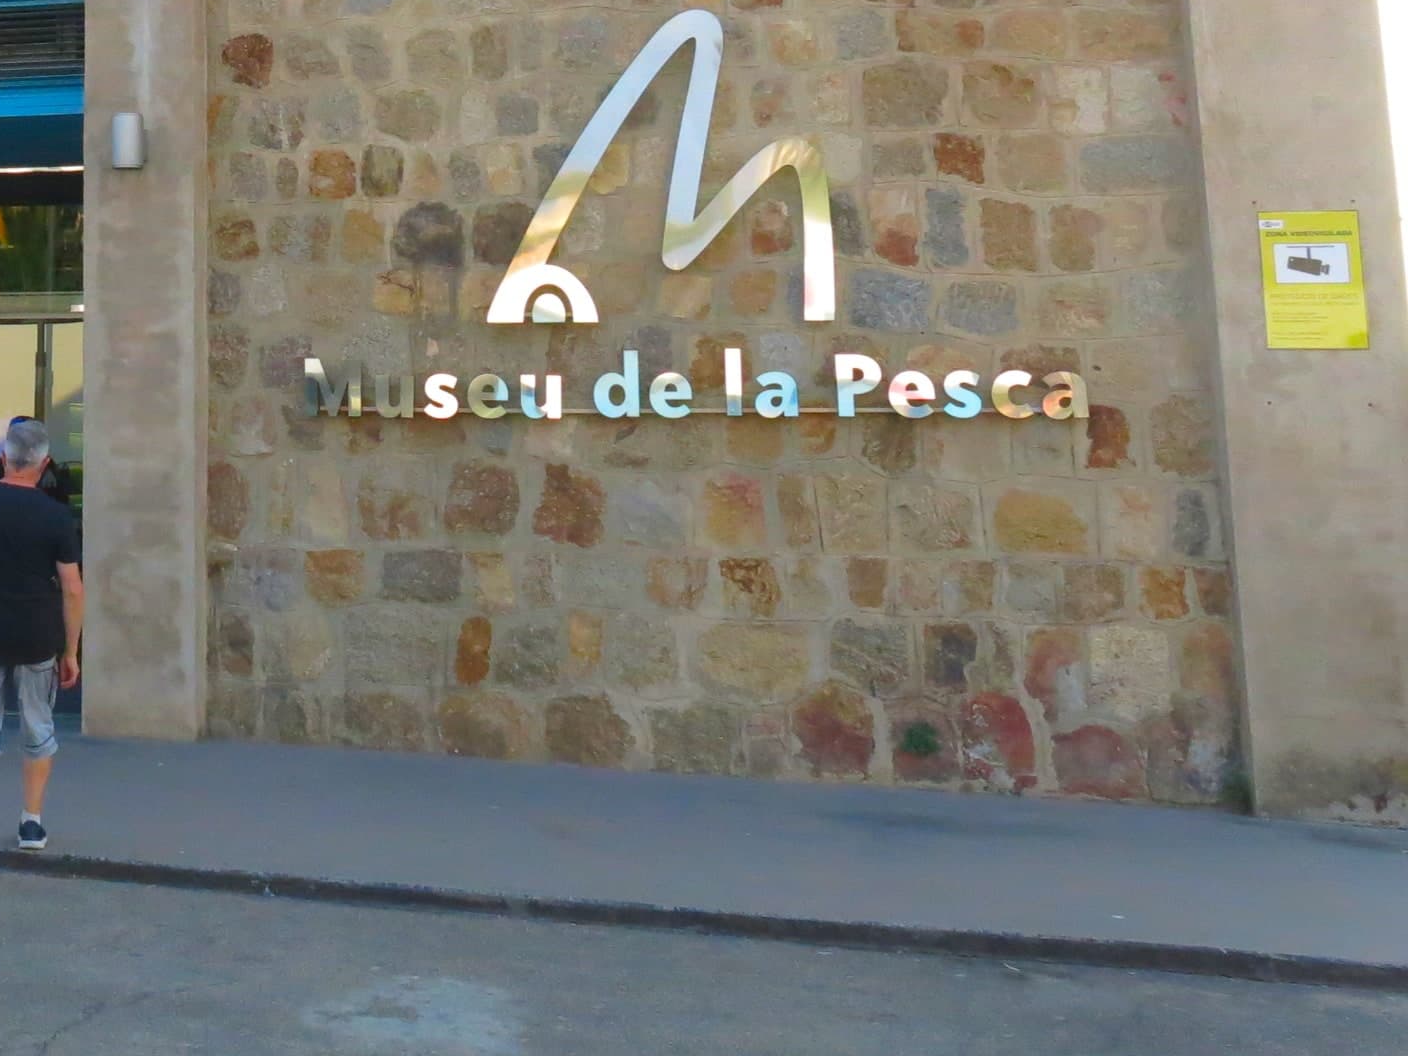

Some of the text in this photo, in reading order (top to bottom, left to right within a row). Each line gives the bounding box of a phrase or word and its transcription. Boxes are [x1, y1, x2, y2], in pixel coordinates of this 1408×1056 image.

[304, 348, 1091, 419] Museu de la Pesca
